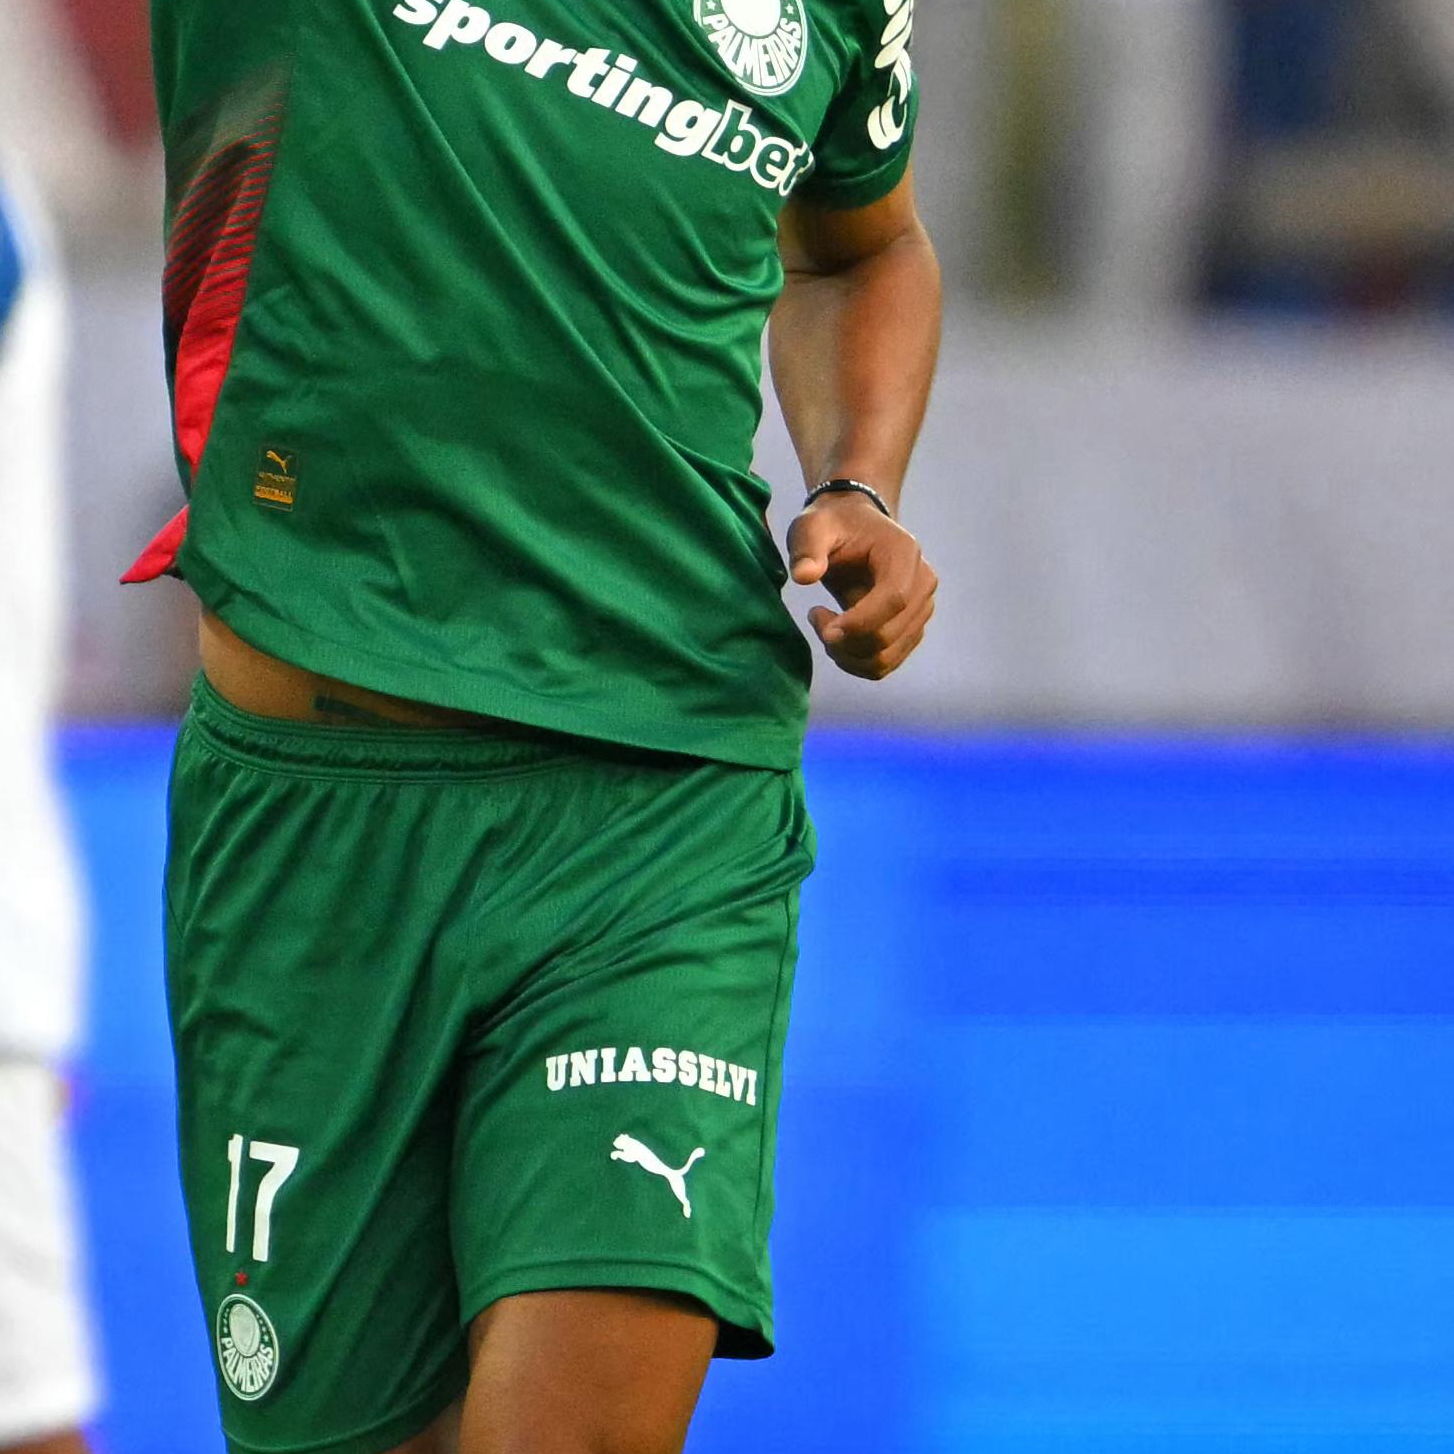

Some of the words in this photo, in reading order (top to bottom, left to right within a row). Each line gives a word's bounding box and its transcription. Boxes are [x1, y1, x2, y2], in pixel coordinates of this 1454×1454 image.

[702, 12, 802, 88] PALMEIRAS
[545, 1046, 758, 1106] UNIASSELVI
[226, 1132, 301, 1263] 17
[220, 1336, 275, 1393] PALMEIRAS
